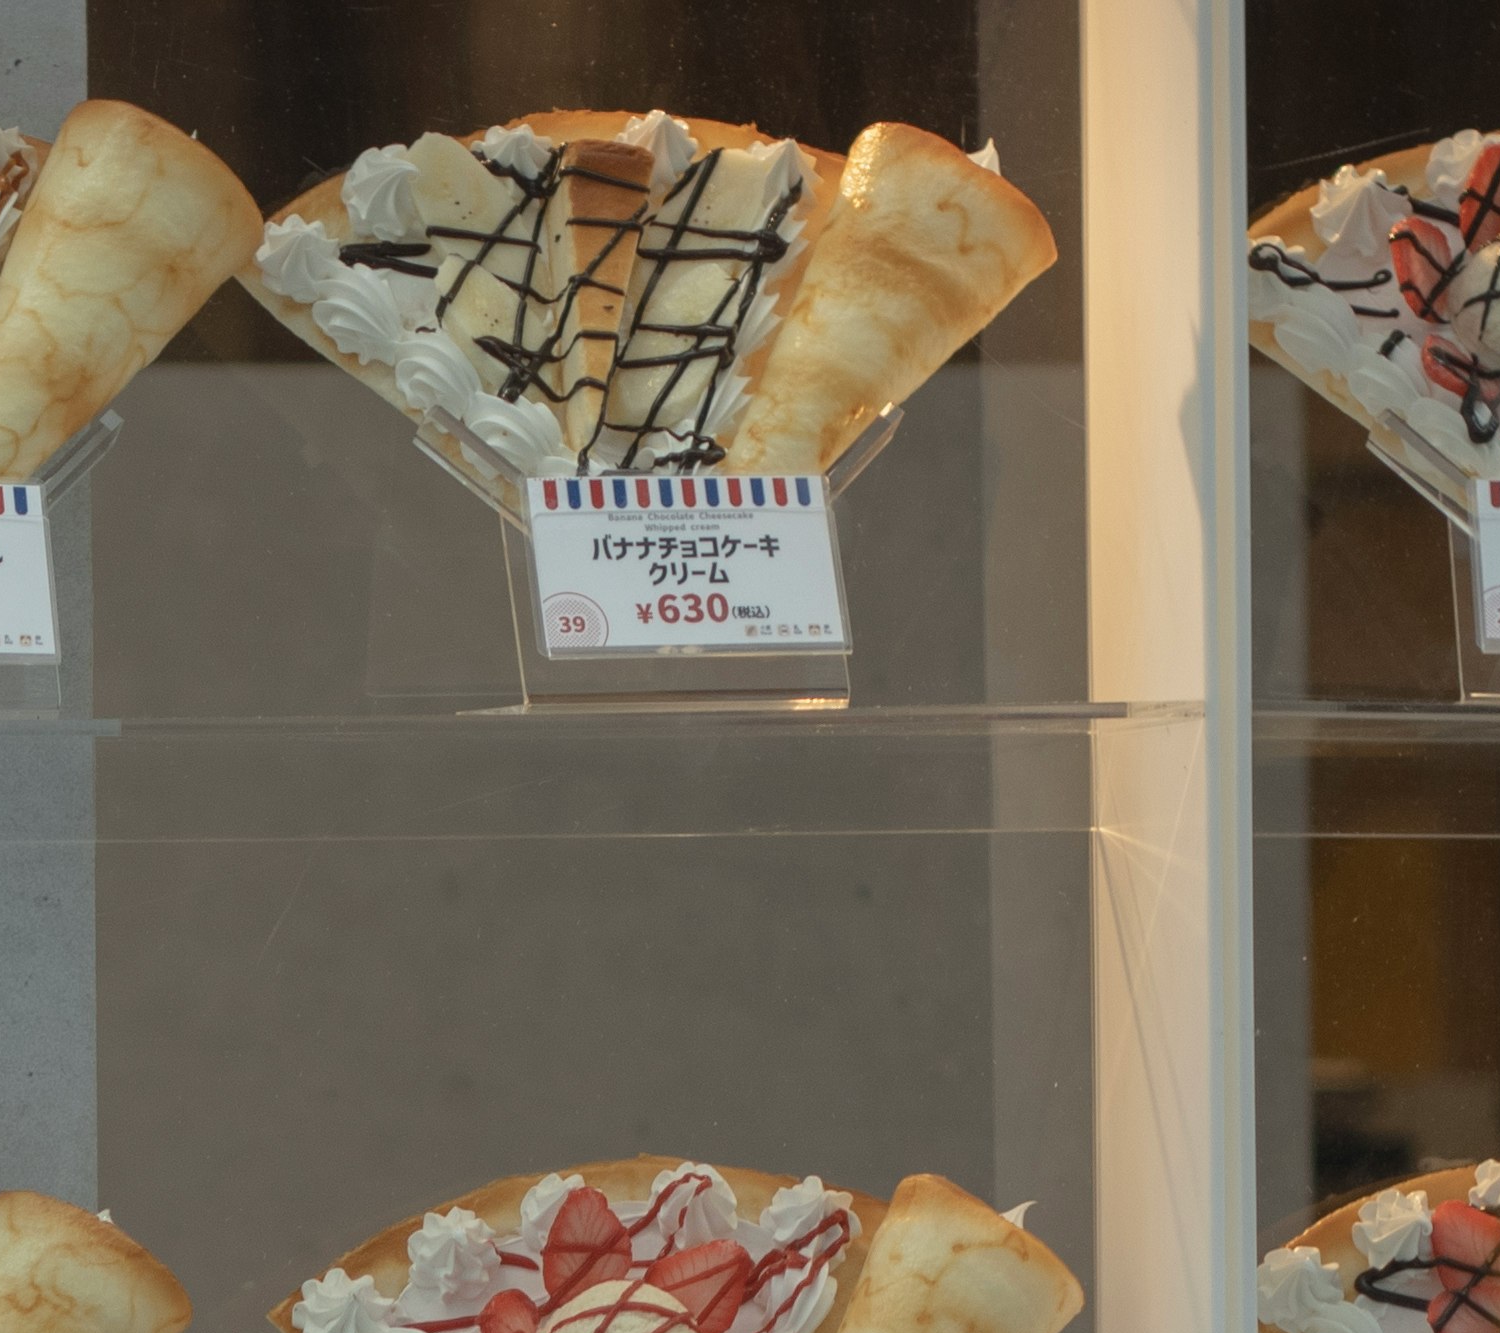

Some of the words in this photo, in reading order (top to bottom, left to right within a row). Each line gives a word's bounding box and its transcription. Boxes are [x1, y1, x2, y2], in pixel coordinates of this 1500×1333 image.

[592, 535, 779, 560] バナナチョコケーキ
[649, 563, 729, 585] クリーム
[636, 593, 728, 624] ¥630
[559, 616, 585, 633] 39
